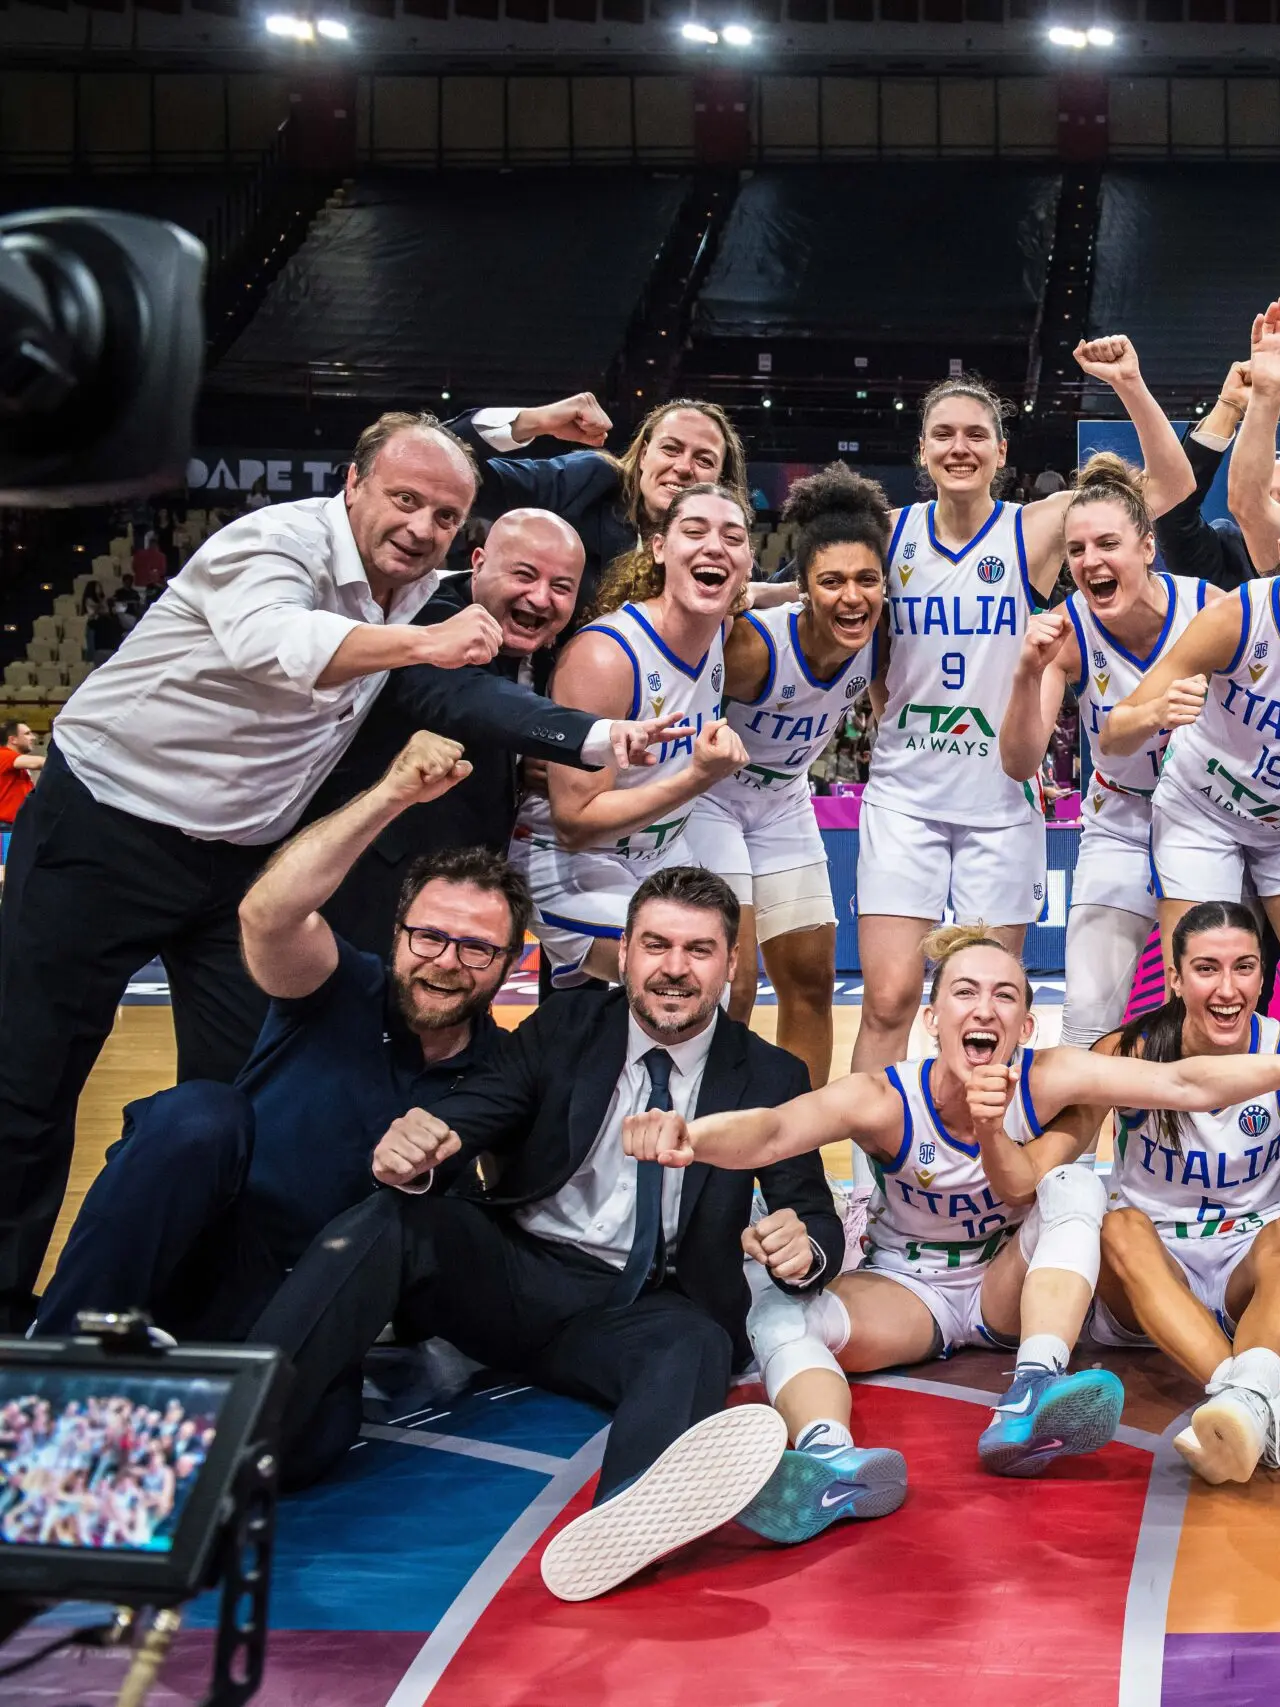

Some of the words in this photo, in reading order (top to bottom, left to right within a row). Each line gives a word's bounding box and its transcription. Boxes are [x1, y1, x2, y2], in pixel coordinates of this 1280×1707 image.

[890, 596, 1016, 636] ITALIA
[942, 652, 966, 690] 9
[745, 704, 852, 743] ITAL
[898, 703, 996, 738] ITA
[895, 1179, 1005, 1219] ITAL
